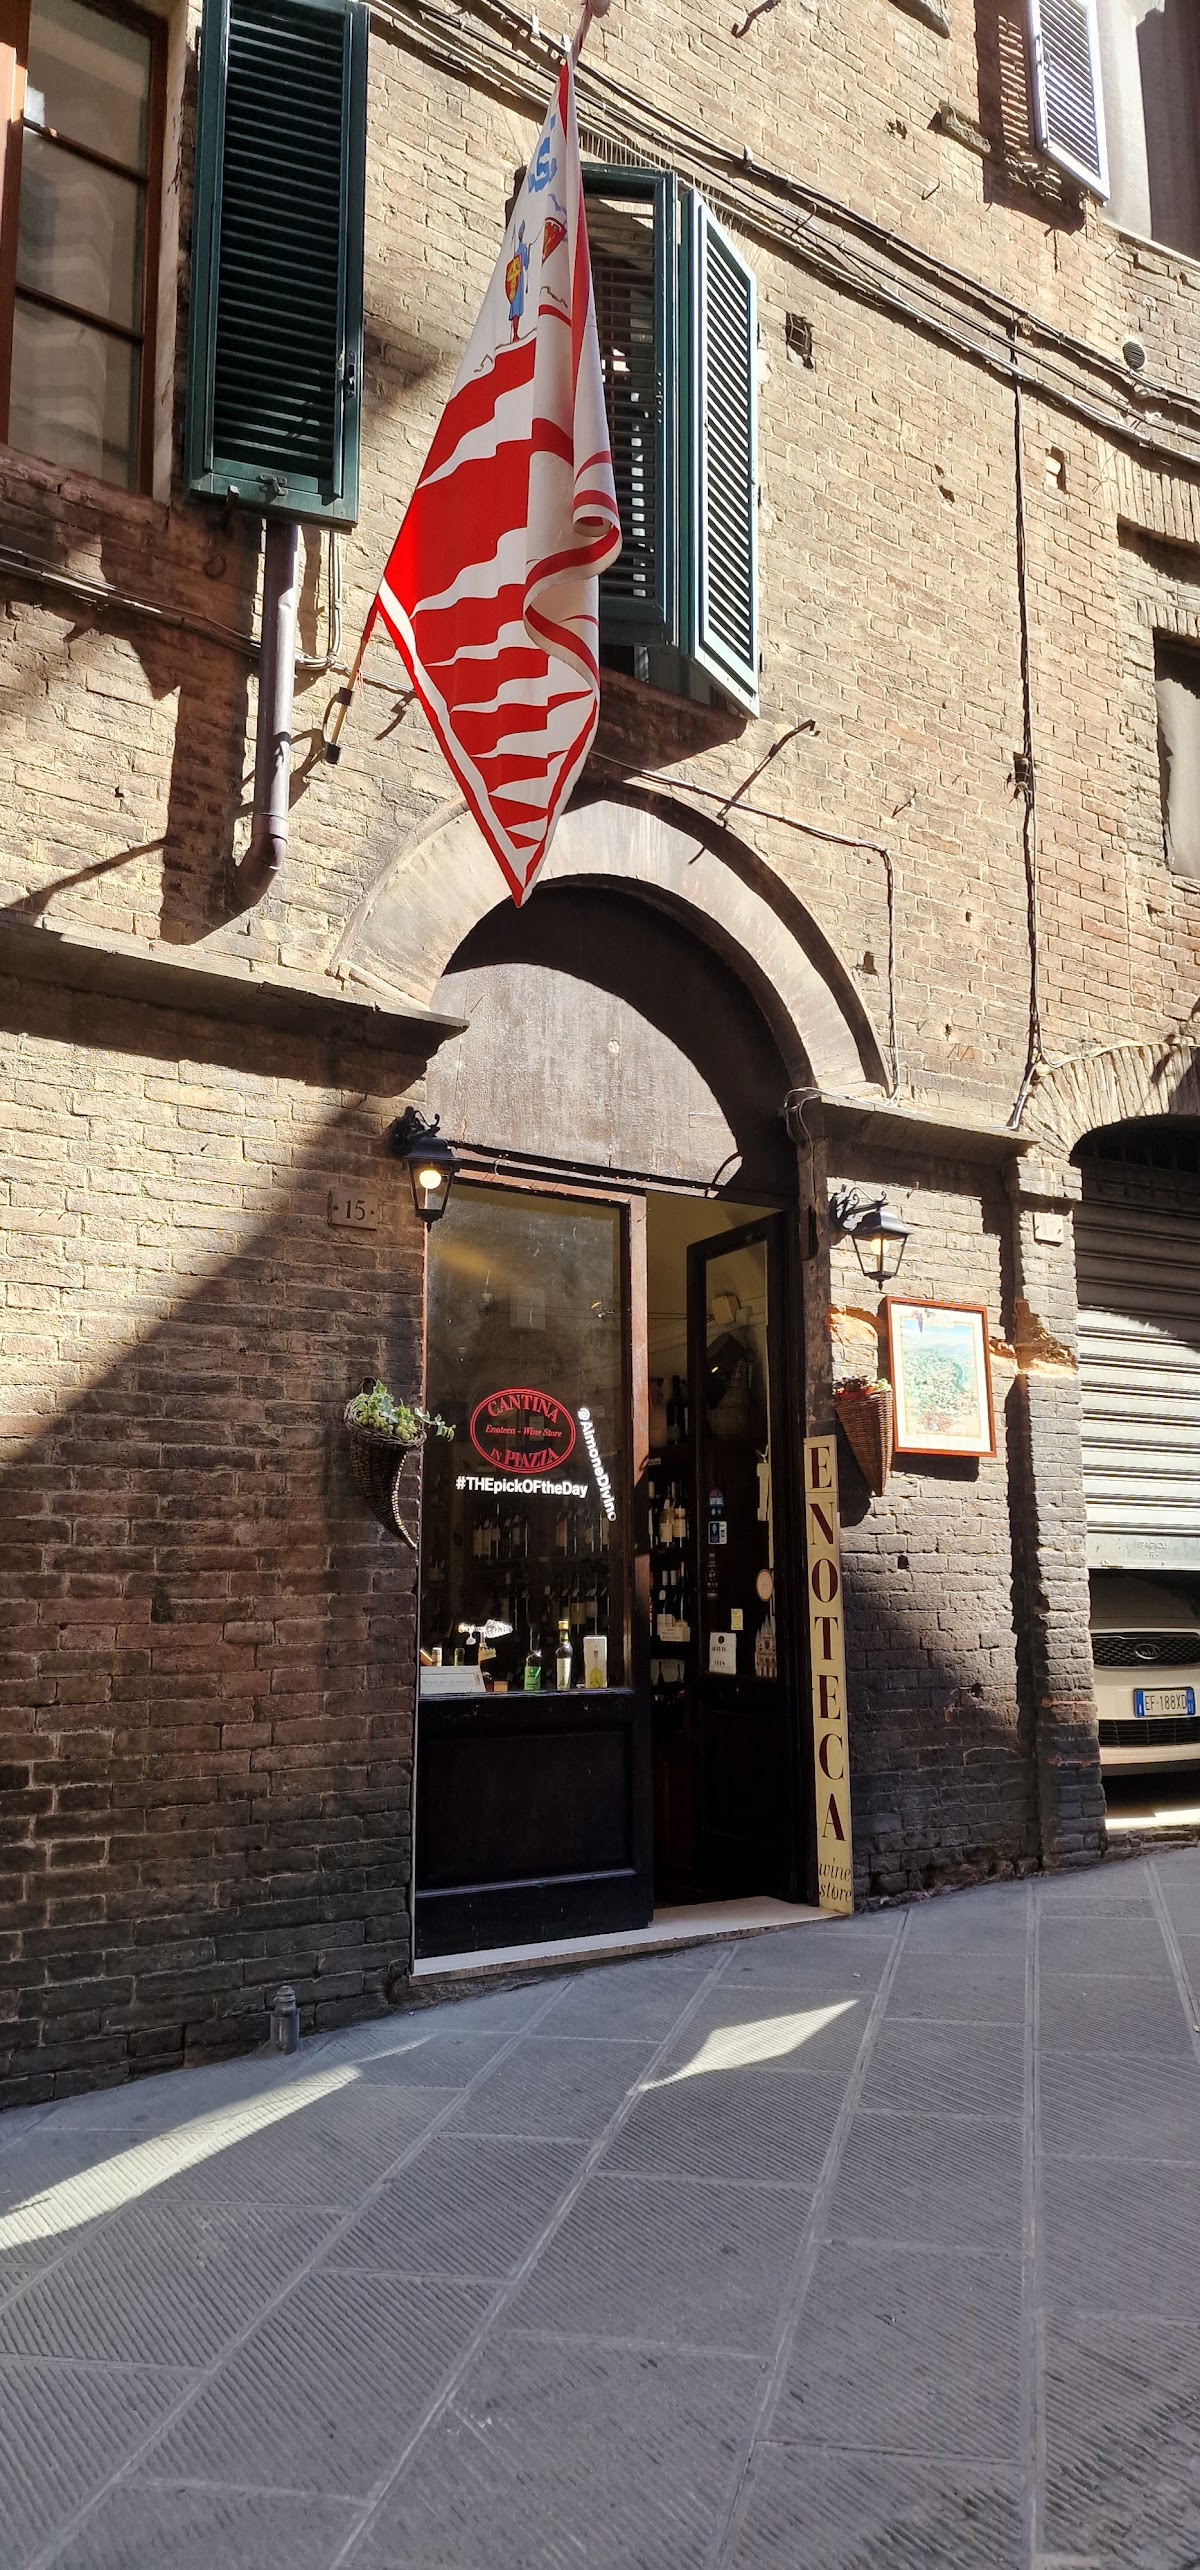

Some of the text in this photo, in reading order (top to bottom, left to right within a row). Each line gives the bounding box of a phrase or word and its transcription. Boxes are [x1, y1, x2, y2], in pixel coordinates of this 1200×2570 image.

[344, 1199, 366, 1221] 15
[487, 1394, 559, 1424] CANTINA
[485, 1424, 516, 1435] Enoteca
[523, 1426, 542, 1437] Wine
[542, 1428, 563, 1438] Store
[490, 1447, 560, 1468] IN PIAZZA
[455, 1475, 589, 1499] #THEpickOFtheDay
[808, 1446, 847, 1842] ENOTECA
[819, 1857, 851, 1882] wine
[819, 1882, 852, 1904] store
